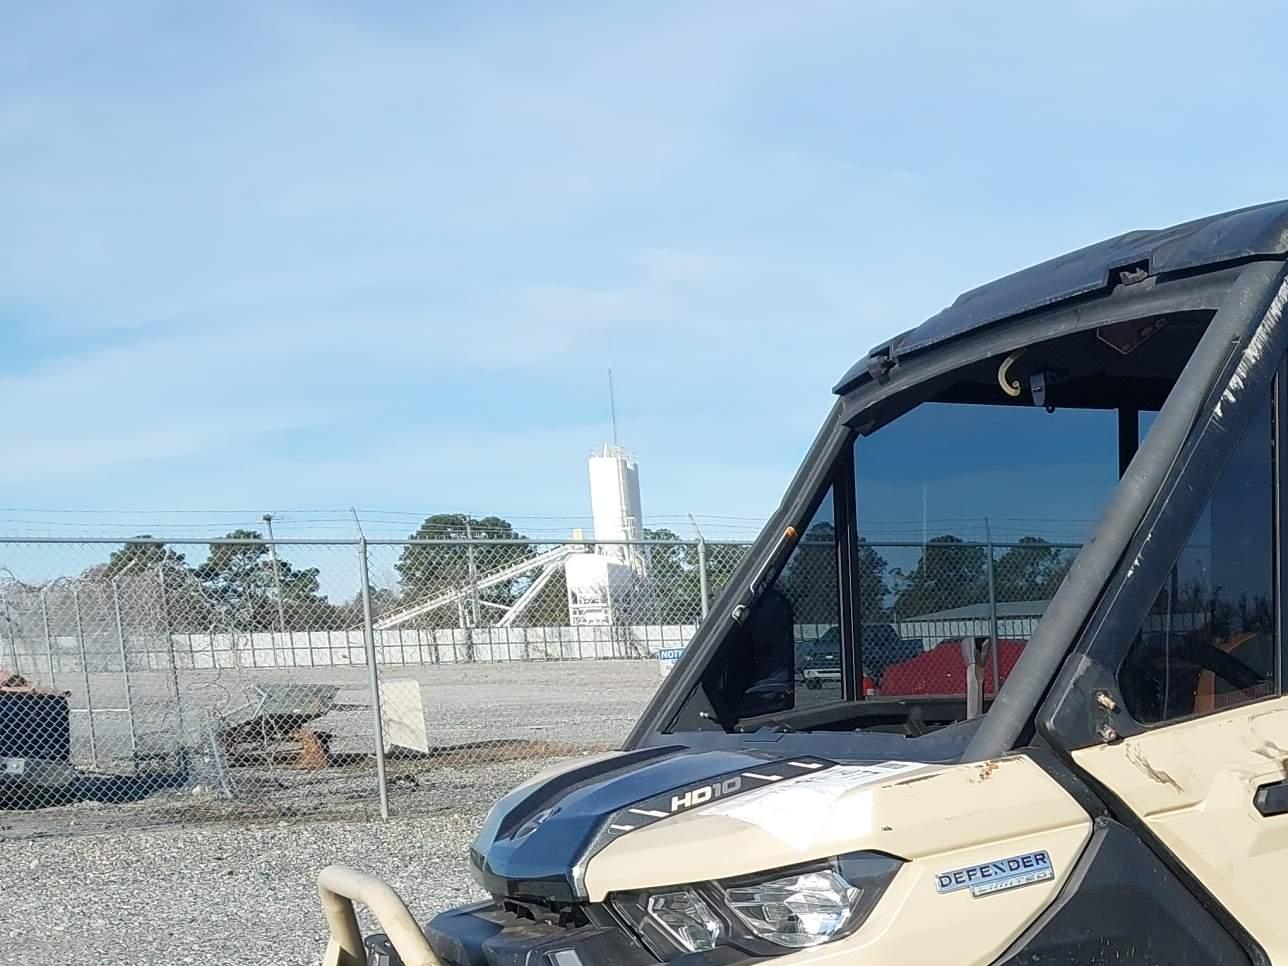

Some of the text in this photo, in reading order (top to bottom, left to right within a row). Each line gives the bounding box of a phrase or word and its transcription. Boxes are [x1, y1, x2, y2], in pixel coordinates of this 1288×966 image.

[661, 650, 685, 659] NOTI
[671, 776, 741, 811] HD10
[938, 853, 1048, 887] DEFENDER
